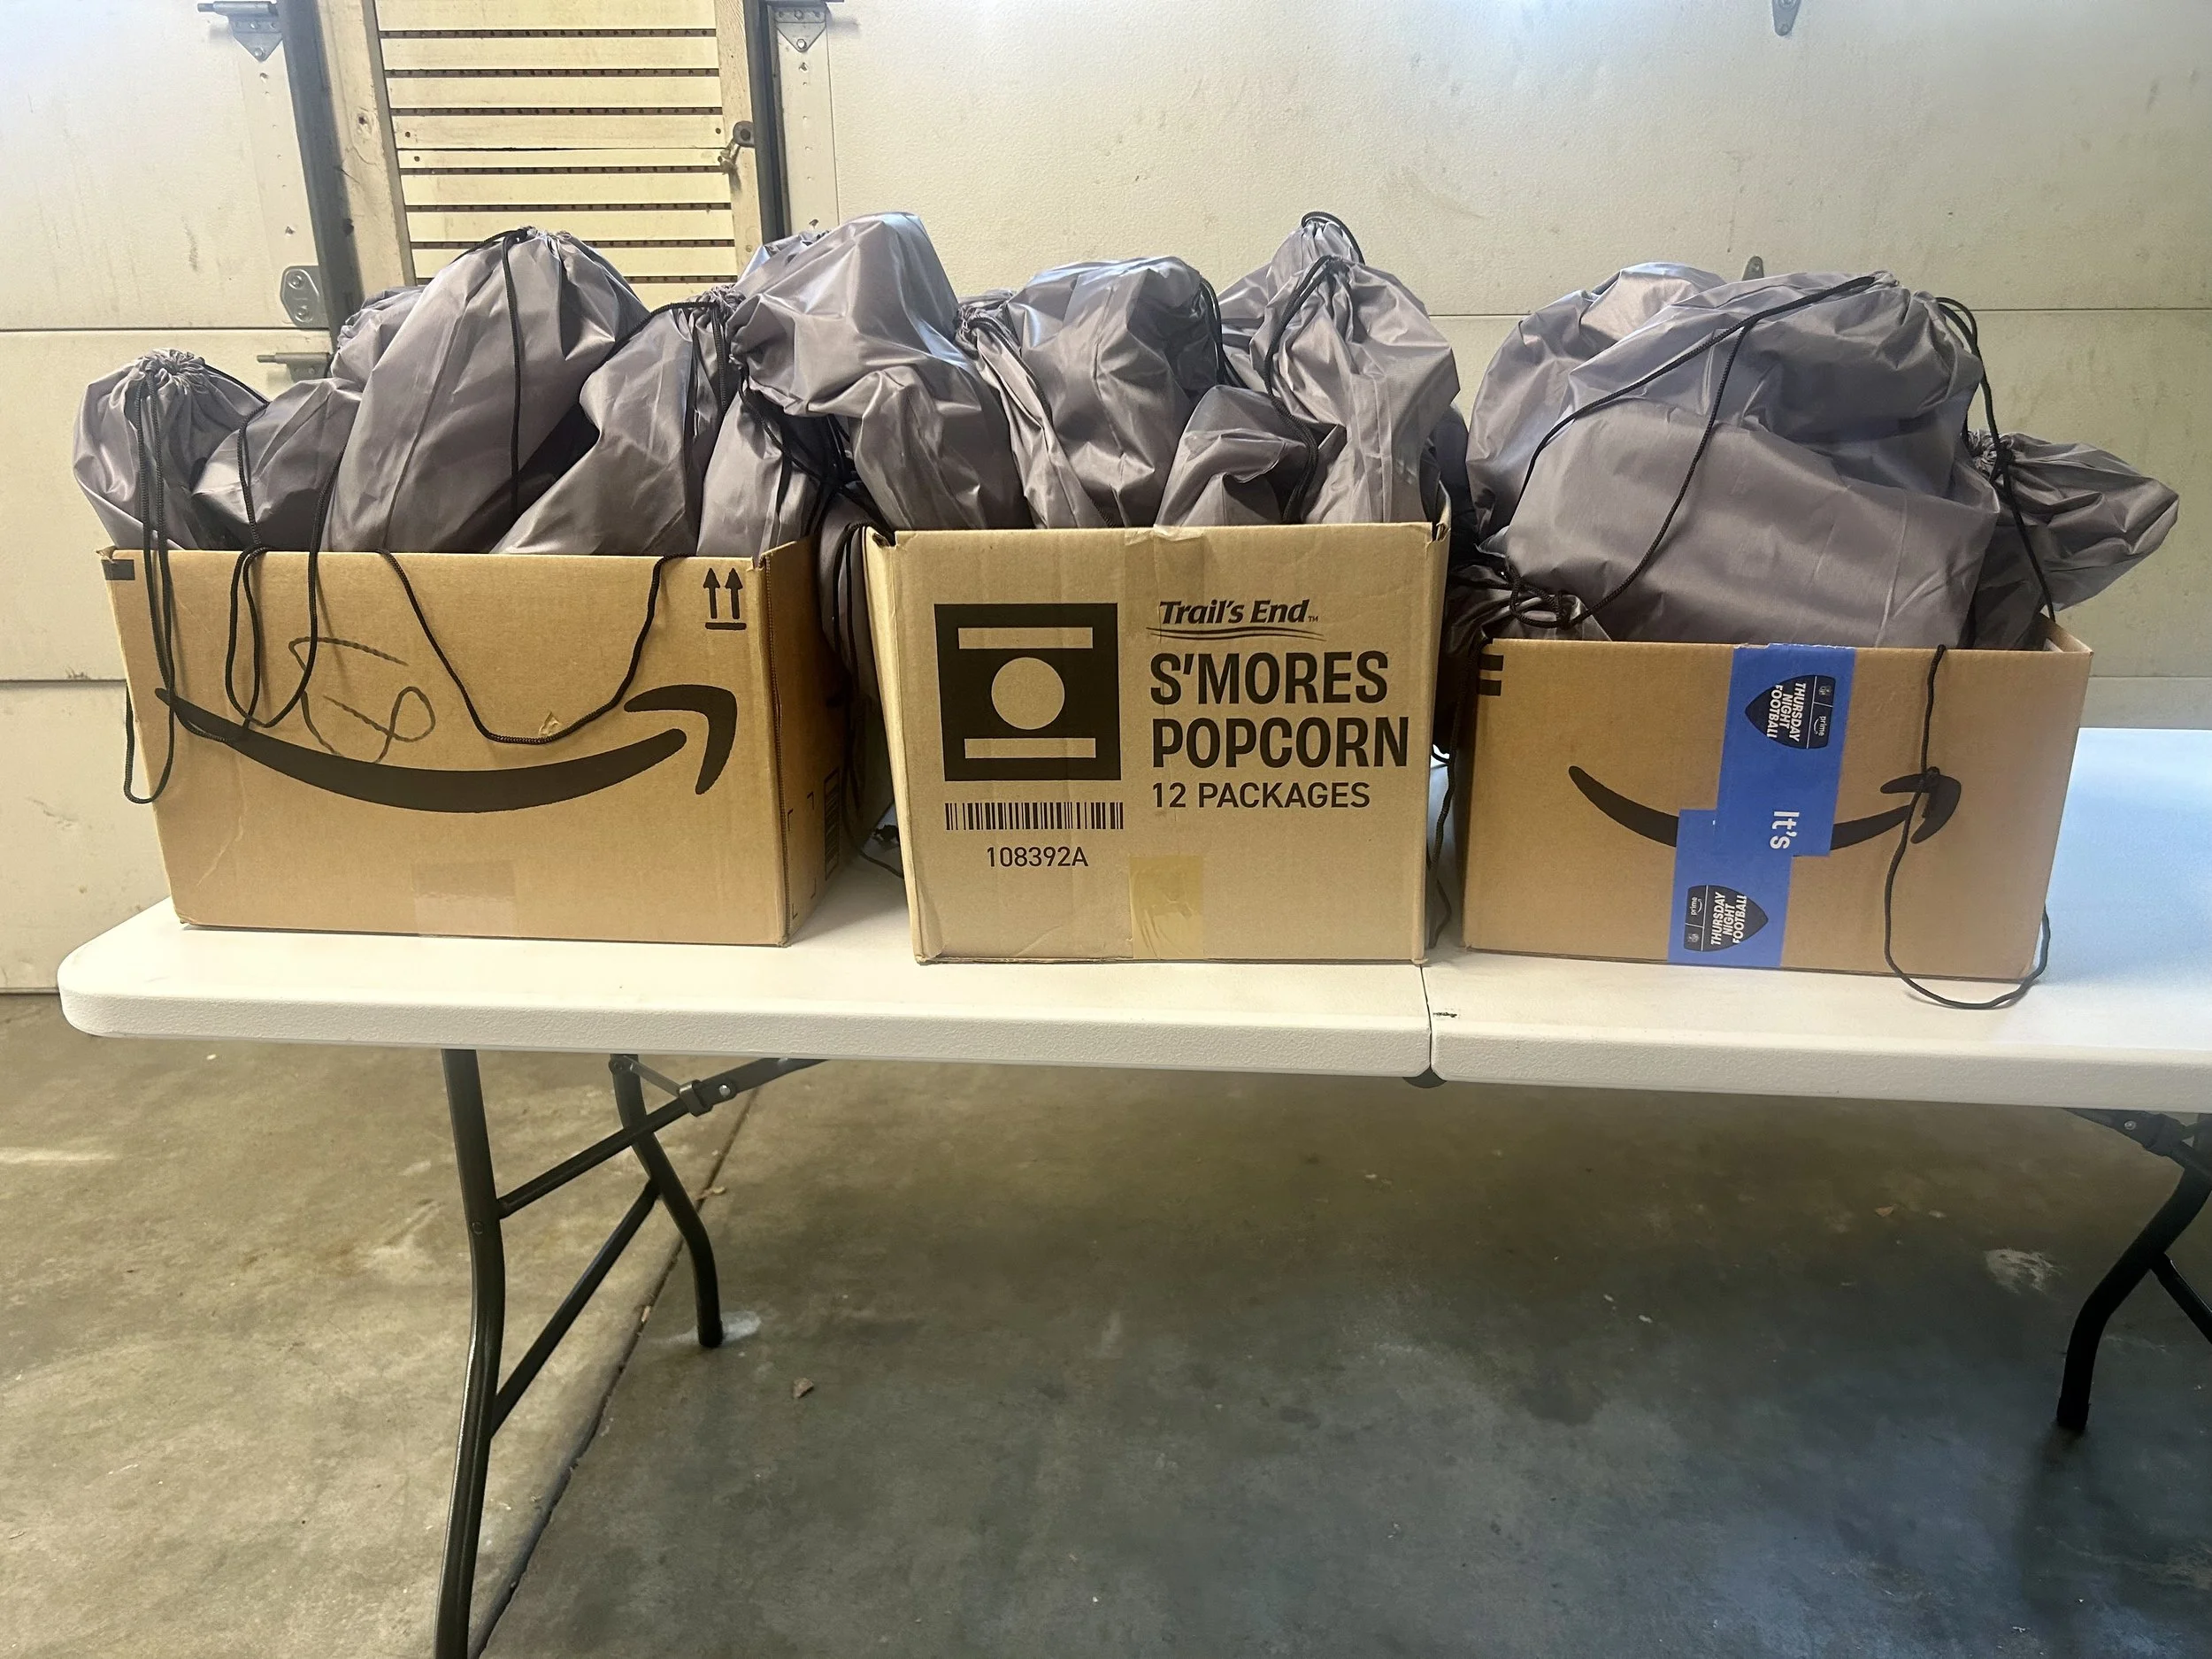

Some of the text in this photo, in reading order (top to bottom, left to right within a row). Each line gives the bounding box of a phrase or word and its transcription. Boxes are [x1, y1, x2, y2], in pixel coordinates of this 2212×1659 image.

[1159, 599, 1245, 625] Trail's
[1249, 598, 1310, 624] End
[1150, 649, 1389, 705] S'MORES
[1766, 684, 1784, 739] FOOTBALL
[1778, 693, 1794, 730] NIGHT
[1788, 682, 1807, 742] THURSDAY
[1818, 716, 1827, 737] prime
[1152, 716, 1409, 769] POPCORN
[1152, 781, 1371, 809] 12 PACKAGES
[1770, 810, 1800, 849] It's
[987, 846, 1089, 867] 108392A
[1710, 891, 1726, 946] THURSDAY
[1722, 902, 1735, 936] NIGHT
[1732, 895, 1747, 944] FOOTBALL
